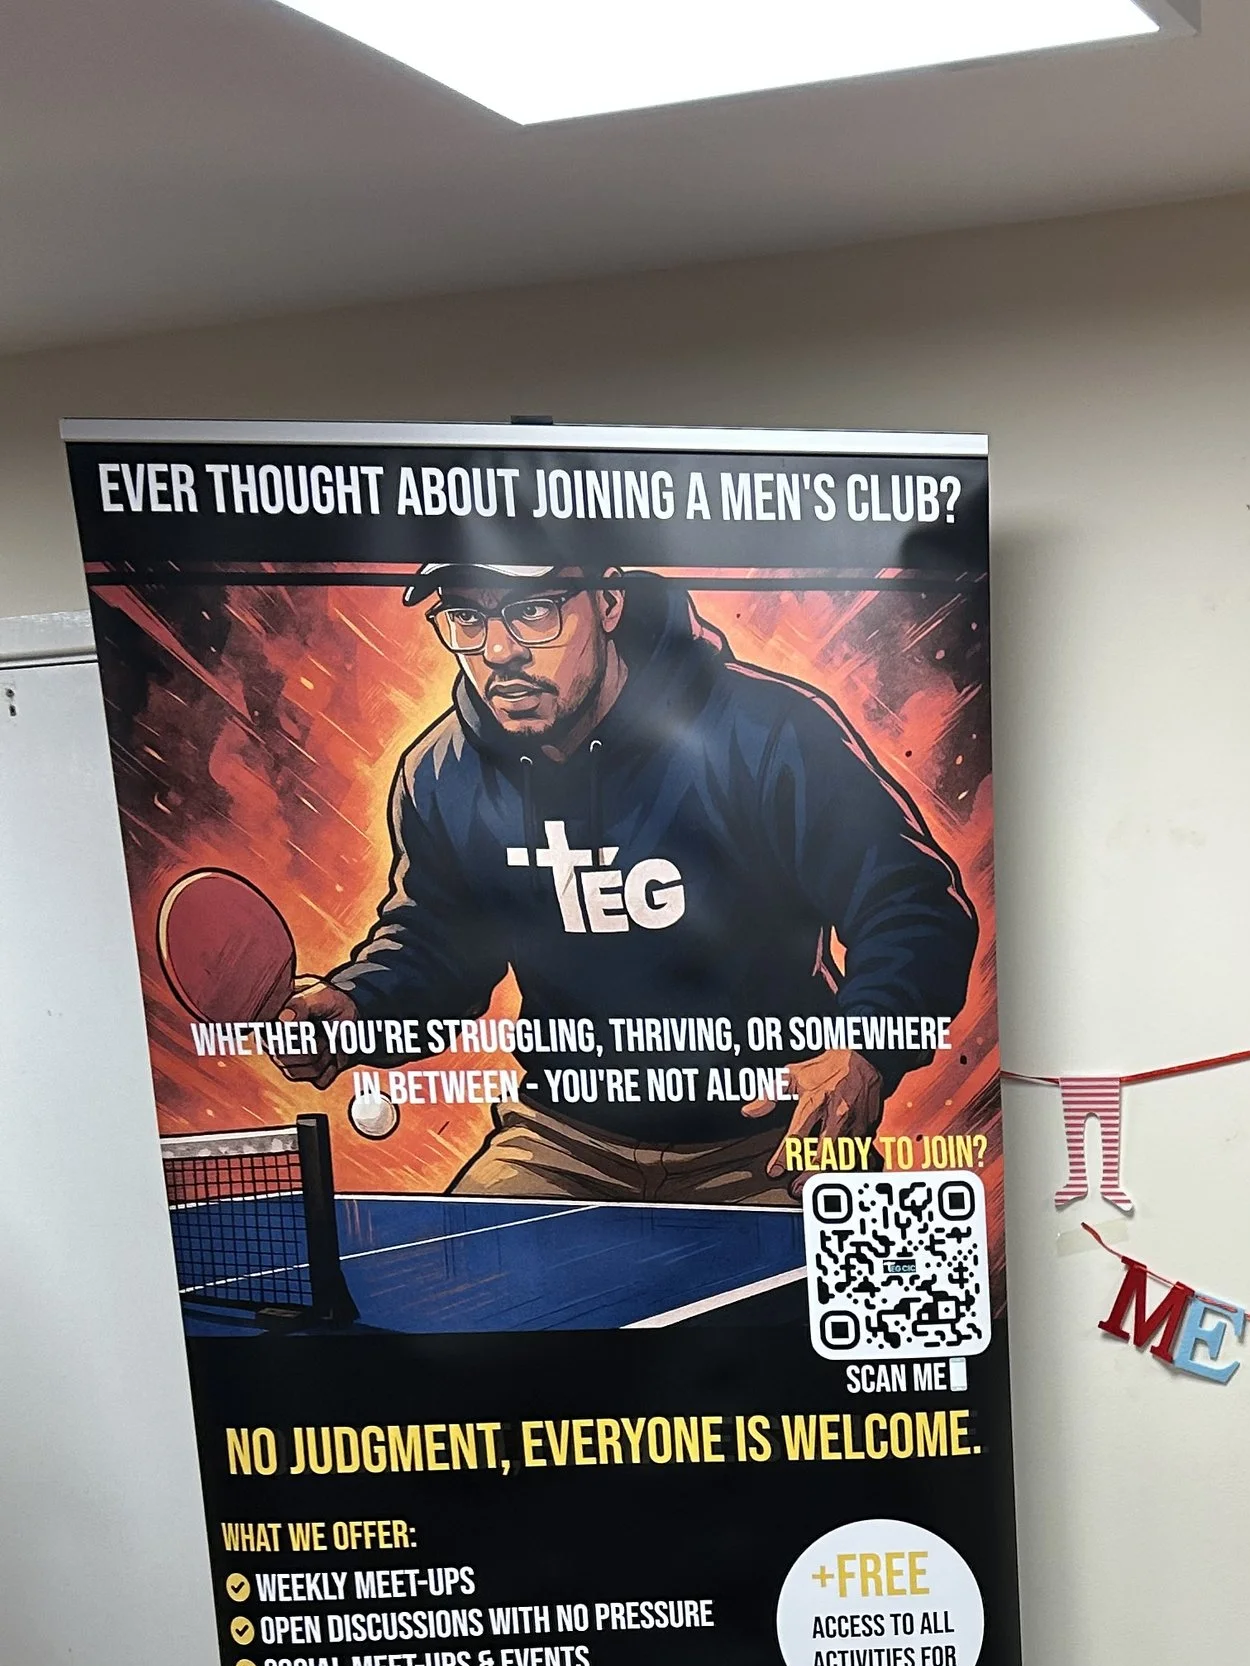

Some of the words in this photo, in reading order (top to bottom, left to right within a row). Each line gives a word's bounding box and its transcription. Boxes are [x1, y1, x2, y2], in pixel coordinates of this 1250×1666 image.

[98, 463, 199, 513] EVER
[205, 464, 384, 515] THOUGHT
[397, 466, 520, 518] ABOUT
[532, 468, 675, 520] JOINING
[681, 471, 712, 521] A
[719, 471, 837, 523] MEN'S
[846, 473, 962, 526] CLUB?
[191, 1019, 317, 1057] WHETHER
[321, 1019, 422, 1055] YOU'RE
[426, 1016, 604, 1060] STRUGGLING,
[608, 1016, 741, 1057] THRIVING,
[747, 1016, 783, 1052] OR
[788, 1016, 953, 1051] SOMEWHERE
[353, 1070, 383, 1105] IN
[390, 1071, 520, 1105] BETWEEN
[543, 1068, 642, 1103] YOU'RE
[646, 1067, 699, 1102] NOT
[705, 1065, 800, 1102] ALONE.
[784, 1136, 873, 1171] READY
[882, 1136, 914, 1170] TO
[921, 1135, 988, 1170] JOIN?
[846, 1363, 907, 1394] SCAN
[912, 1362, 948, 1392] ME
[225, 1427, 278, 1476] NO
[290, 1422, 511, 1476] JUDGMENT,
[521, 1416, 726, 1467] EVERYONE
[735, 1414, 772, 1462] IS
[781, 1409, 981, 1461] WELCOME.
[221, 1522, 282, 1552] WHAT
[287, 1522, 328, 1552] WE
[332, 1519, 417, 1551] OFFER:
[255, 1571, 348, 1602] WEEKLY
[353, 1566, 476, 1600] MEET-UPS
[812, 1551, 930, 1599] +FREE
[260, 1615, 322, 1645] OPEN
[326, 1608, 484, 1643] DISCUSSIONS
[487, 1605, 551, 1636] WITH
[556, 1603, 589, 1633] NO
[594, 1599, 715, 1631] PRESSURE
[812, 1613, 885, 1639] ACCESS
[889, 1612, 915, 1636] TO
[920, 1610, 955, 1635] ALL
